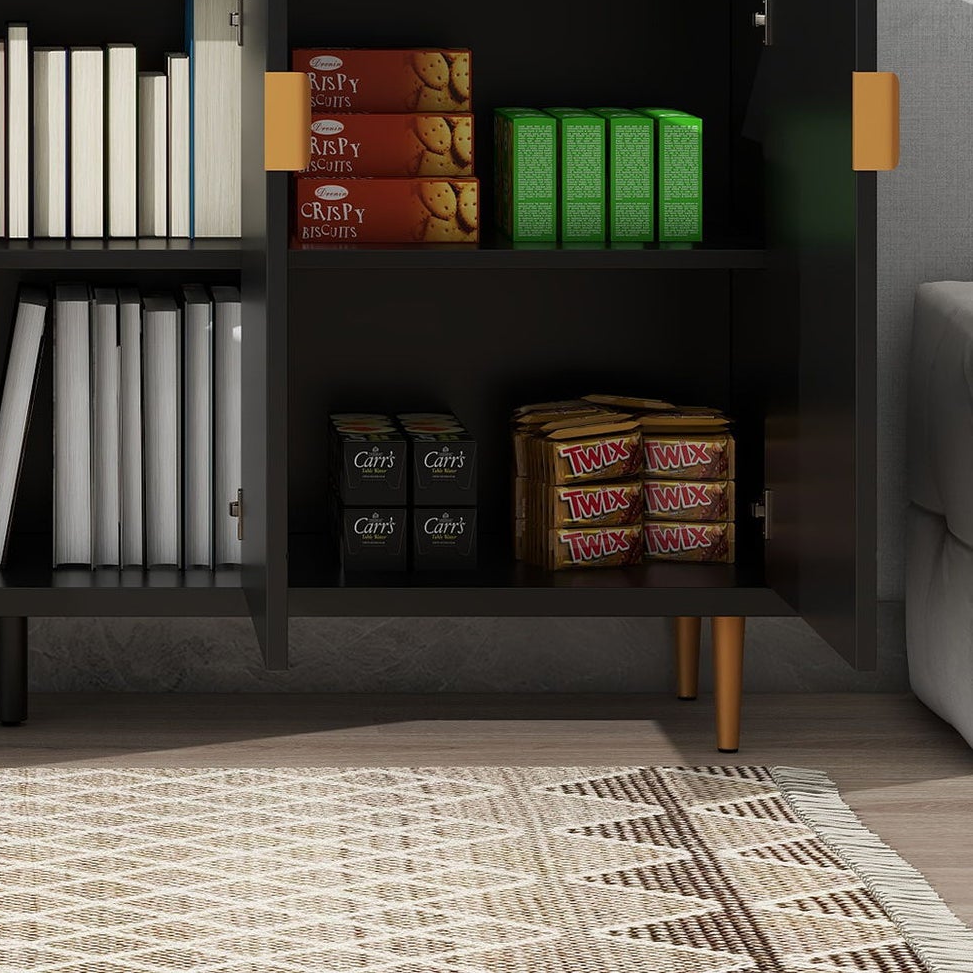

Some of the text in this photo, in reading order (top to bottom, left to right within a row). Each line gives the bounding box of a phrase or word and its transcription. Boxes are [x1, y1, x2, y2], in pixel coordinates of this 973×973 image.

[307, 72, 360, 94] RISPY
[311, 93, 352, 108] SCUITS
[310, 136, 361, 158] RISPY
[299, 158, 353, 173] SCUITS
[300, 201, 365, 224] CRISPY
[302, 223, 357, 240] BISCUITS
[354, 450, 395, 468] Carr's
[424, 450, 465, 468] Carr's
[354, 517, 396, 534] Carr's
[424, 517, 466, 534] Carr's
